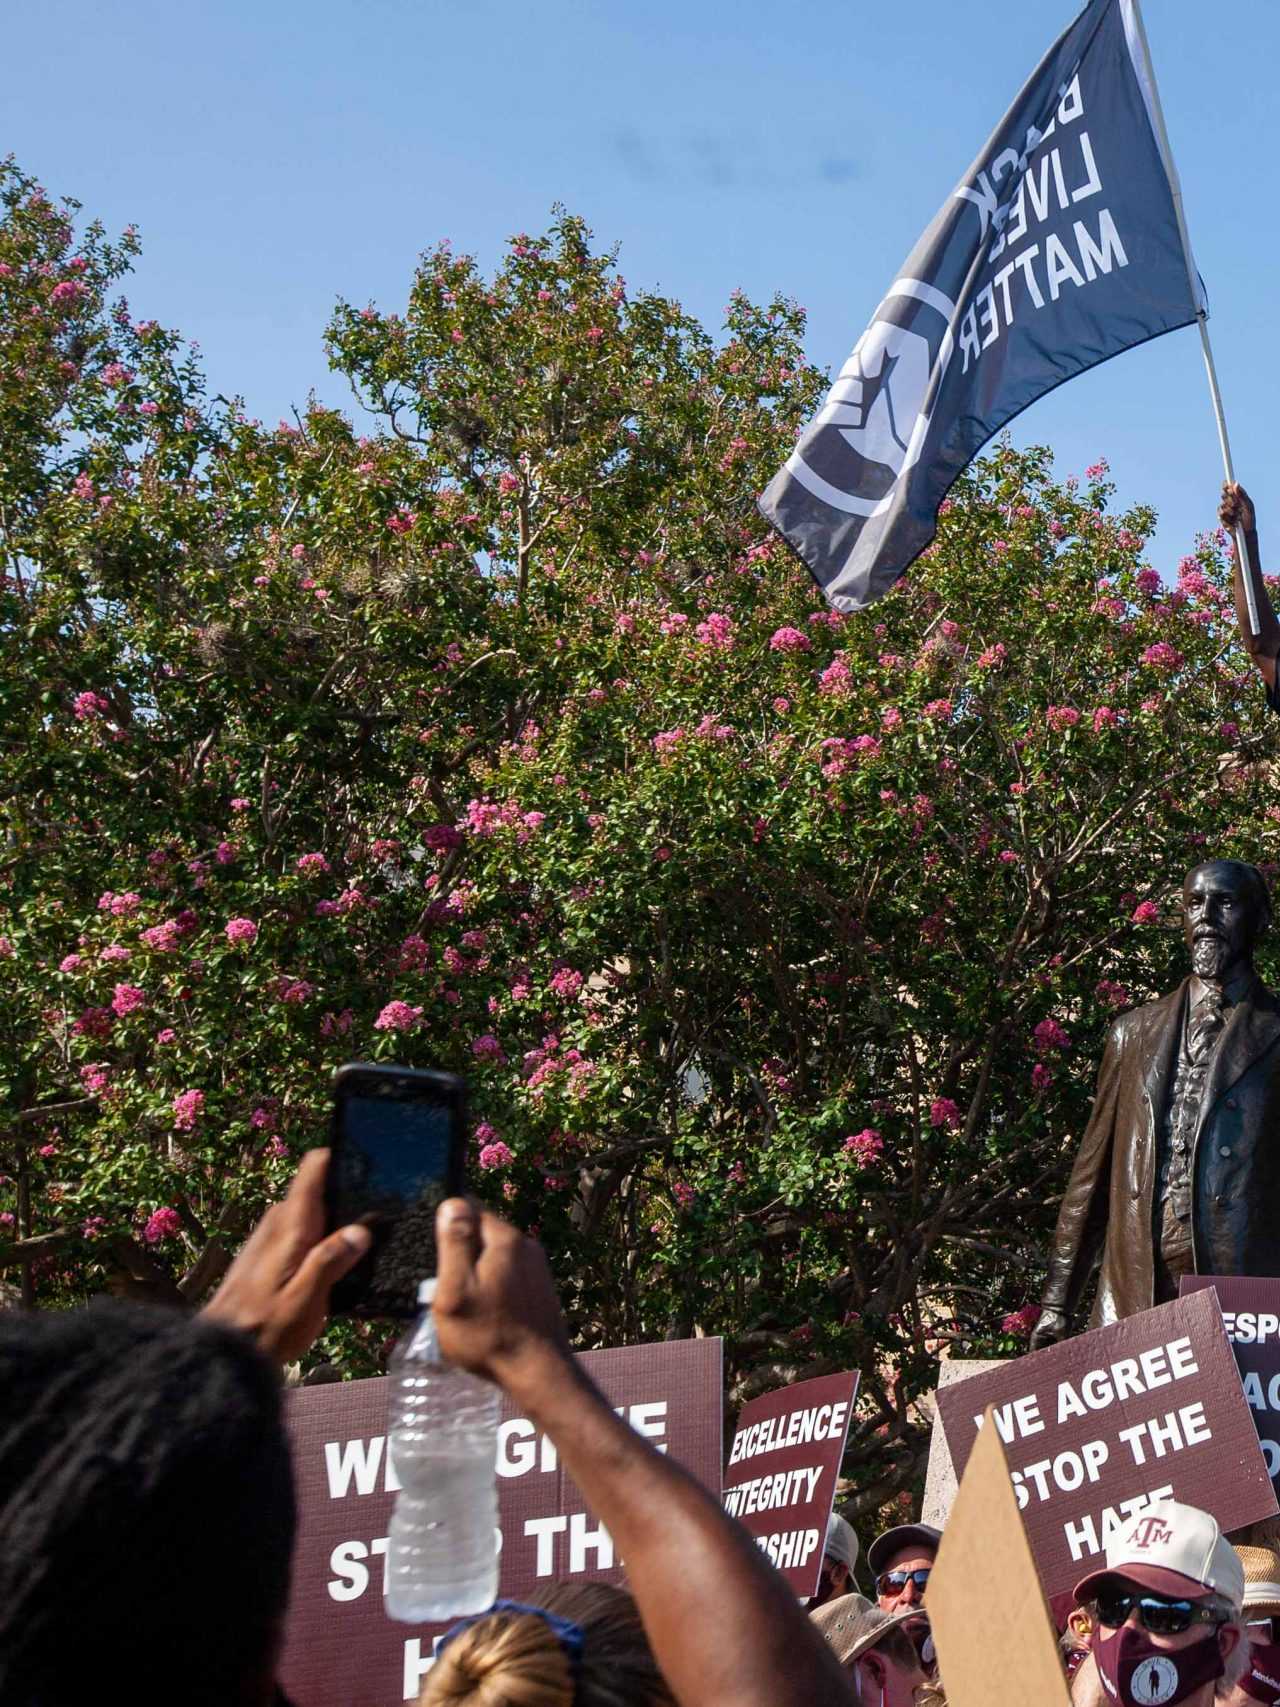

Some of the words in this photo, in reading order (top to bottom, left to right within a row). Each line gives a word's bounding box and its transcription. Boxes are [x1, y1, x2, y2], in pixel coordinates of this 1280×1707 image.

[1057, 1336, 1199, 1424] AGREE
[729, 1401, 848, 1466] EXCELLENCE
[1119, 1402, 1212, 1465] THE
[724, 1465, 824, 1519] INTEGRITY
[524, 1513, 625, 1577] TH
